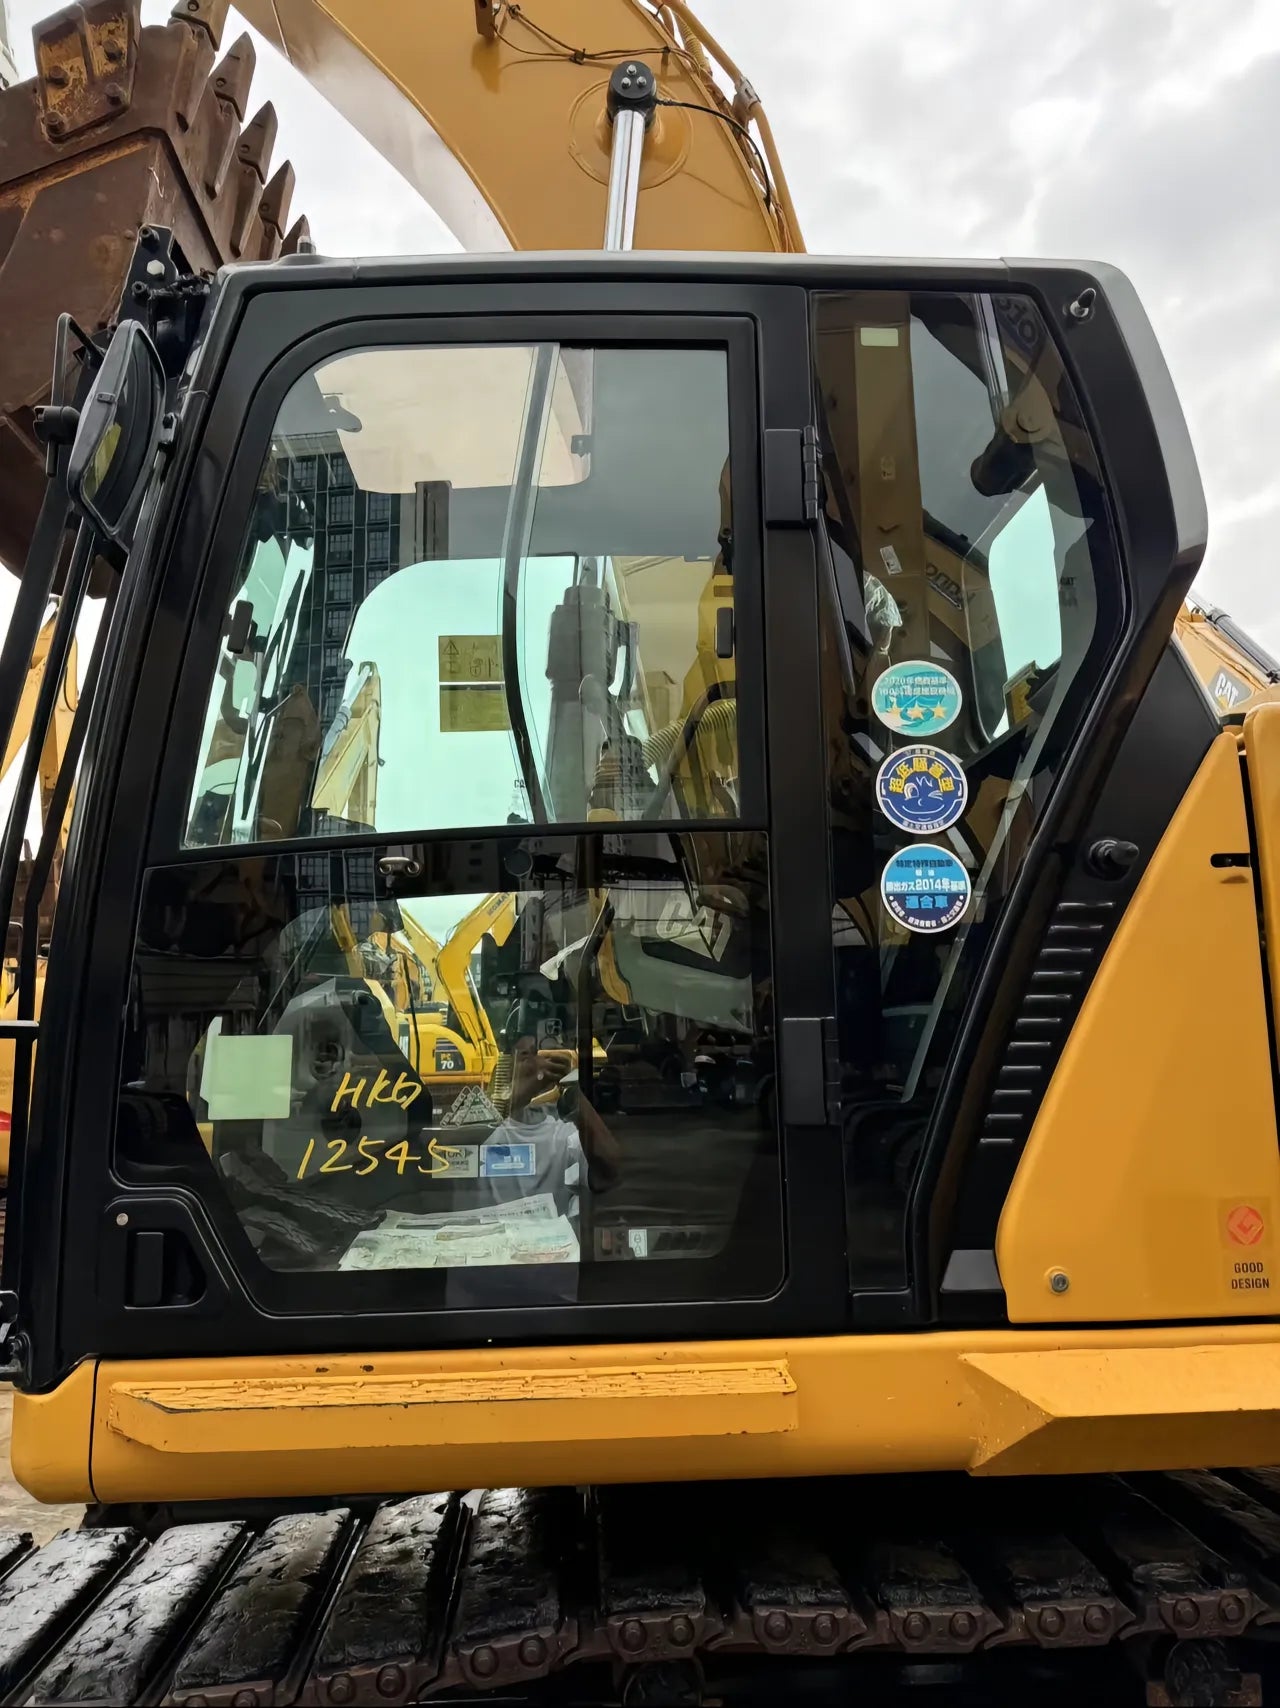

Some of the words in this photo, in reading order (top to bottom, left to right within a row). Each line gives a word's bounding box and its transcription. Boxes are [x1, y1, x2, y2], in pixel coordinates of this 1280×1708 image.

[1214, 672, 1240, 709] CAT
[440, 1060, 455, 1070] 70
[296, 1135, 461, 1180] 12545
[1234, 1262, 1264, 1273] GOOD
[1231, 1278, 1270, 1290] DESIGN
